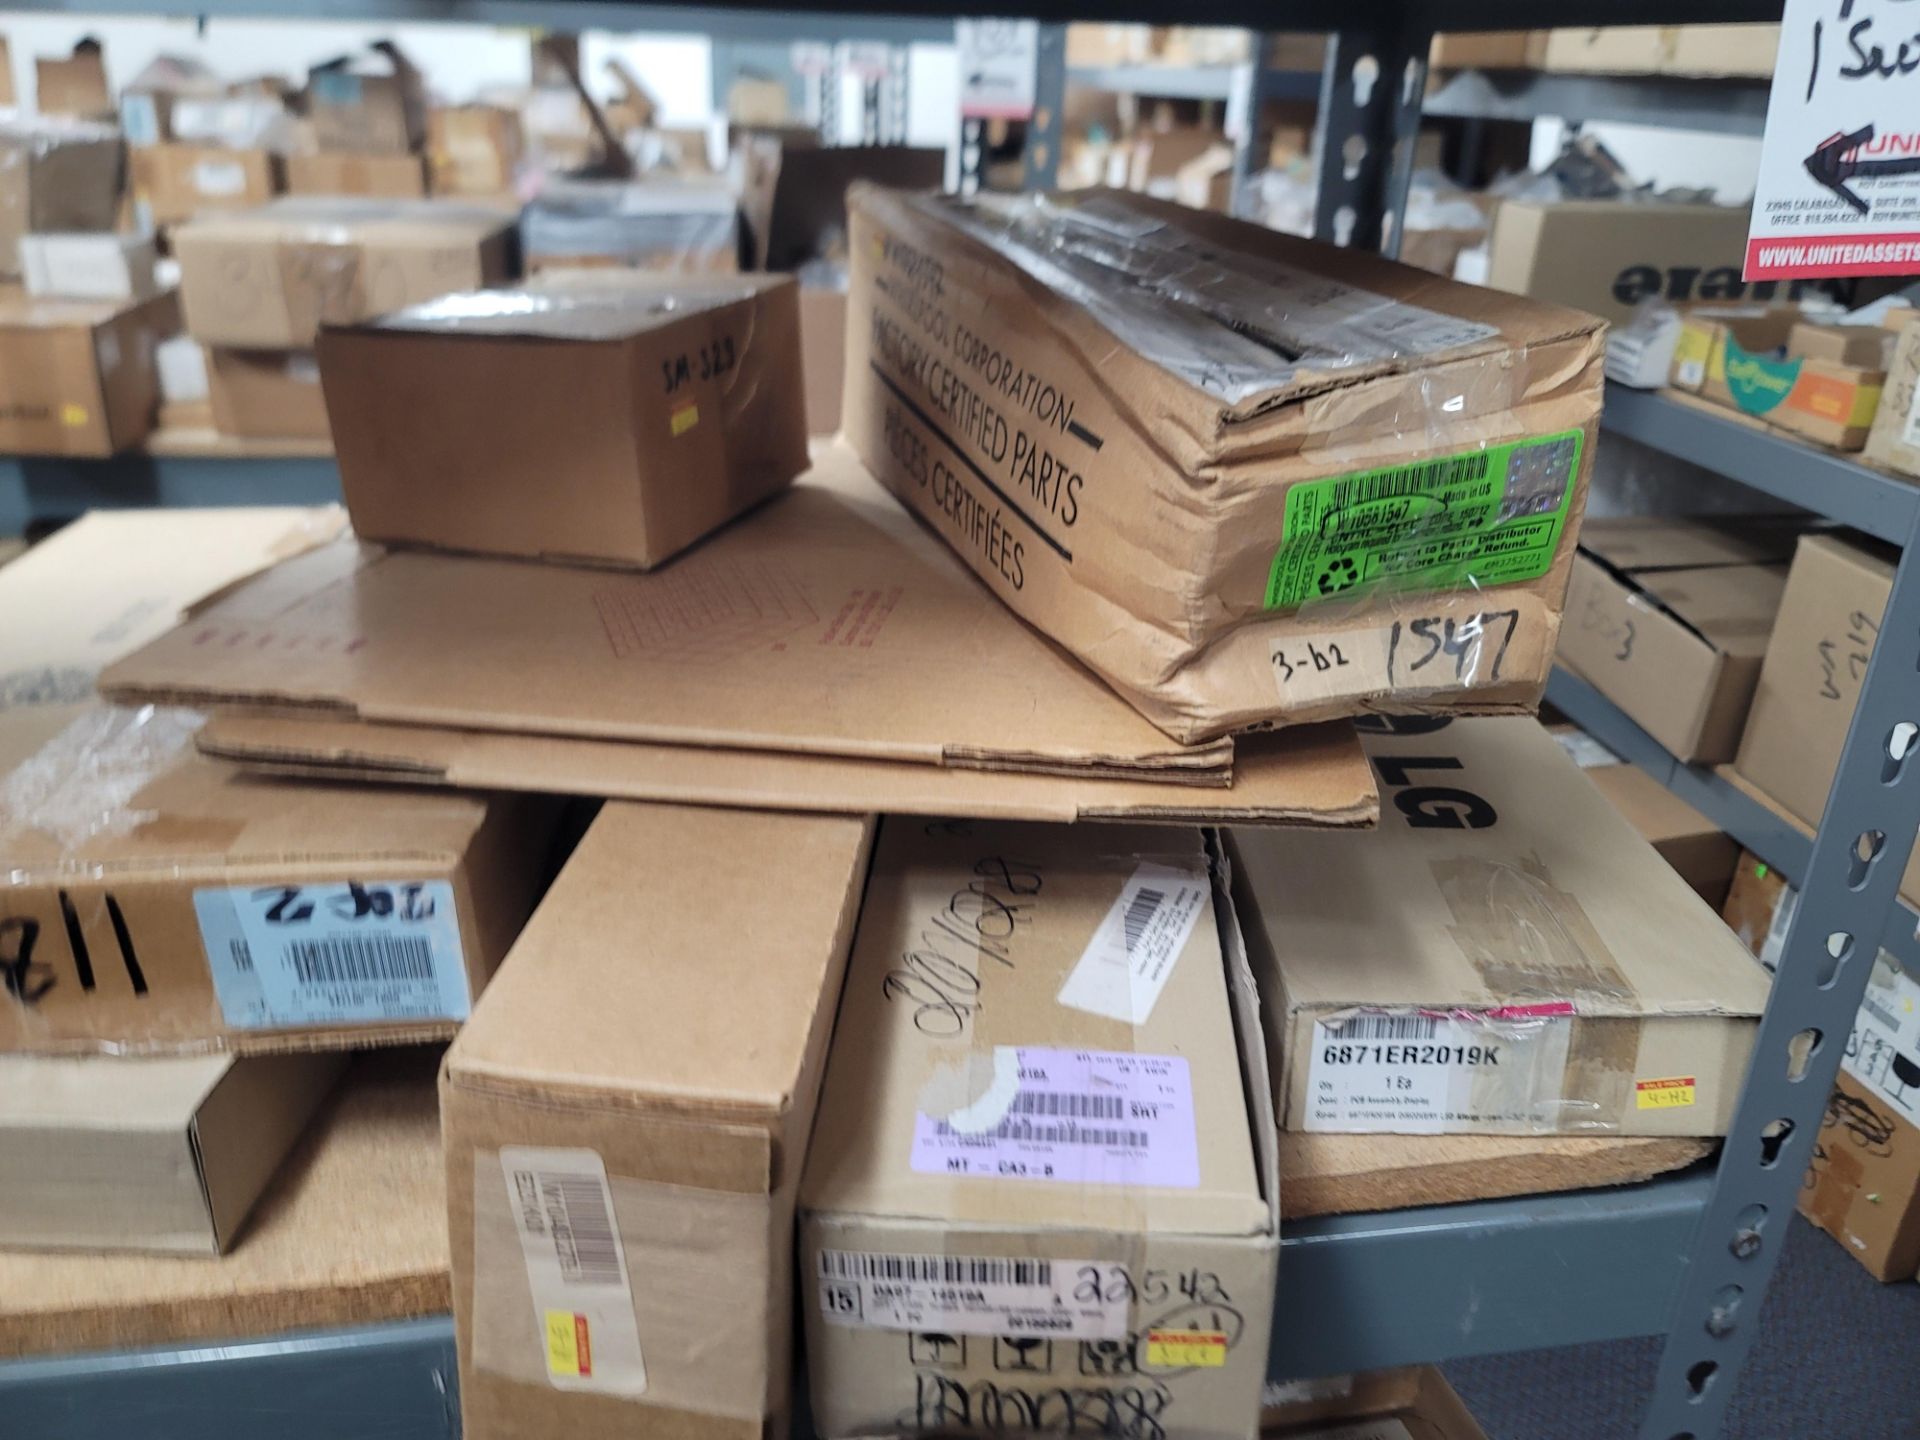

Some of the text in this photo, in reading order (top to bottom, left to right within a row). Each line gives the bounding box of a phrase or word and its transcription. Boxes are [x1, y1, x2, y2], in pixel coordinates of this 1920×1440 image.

[953, 323, 1075, 435] CORPORATION
[928, 359, 1008, 464] CERTIFIED
[1010, 429, 1084, 527] PARTS
[932, 459, 1025, 592] CERTIFIÉES
[1477, 524, 1543, 545] Distributor
[1372, 756, 1498, 829] LG
[1323, 1044, 1499, 1066] 6871ER2019K
[1072, 1265, 1232, 1304] 22542
